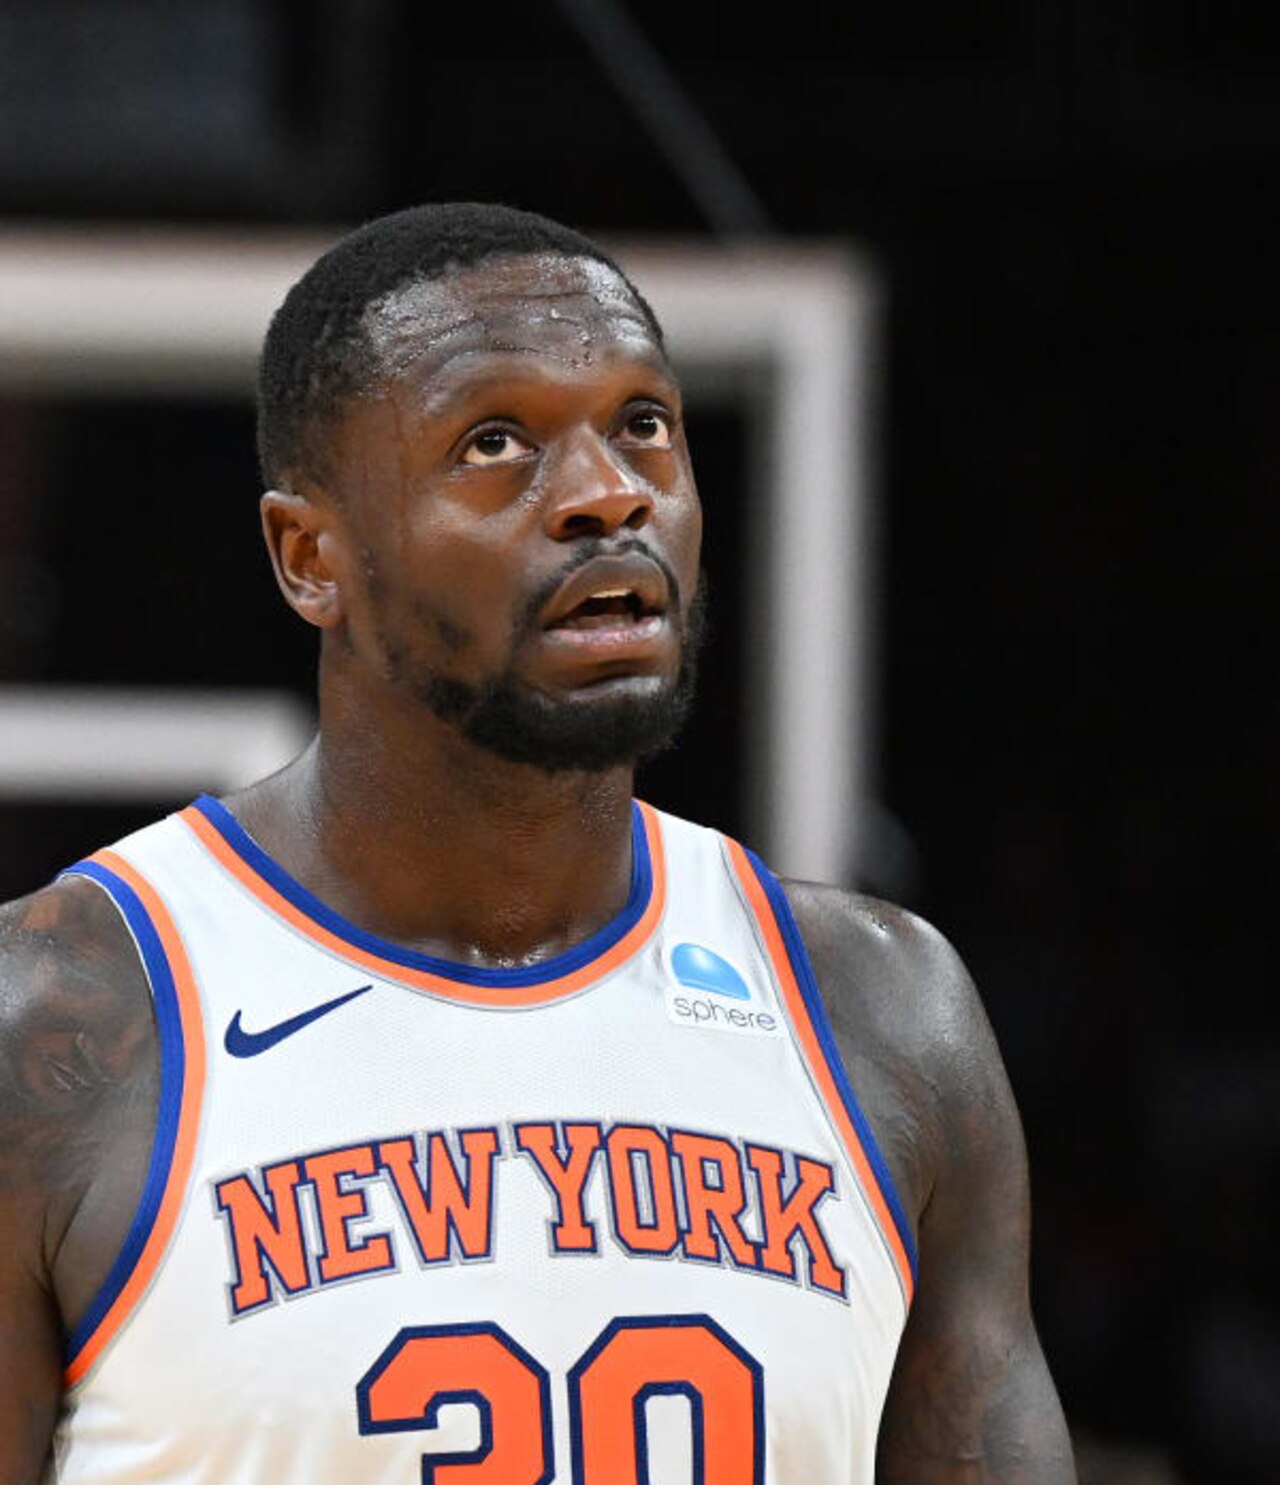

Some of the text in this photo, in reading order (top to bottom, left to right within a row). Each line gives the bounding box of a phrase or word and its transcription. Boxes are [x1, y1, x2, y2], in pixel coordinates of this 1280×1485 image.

[673, 997, 778, 1032] sphere
[211, 1120, 851, 1324] NEW YORK
